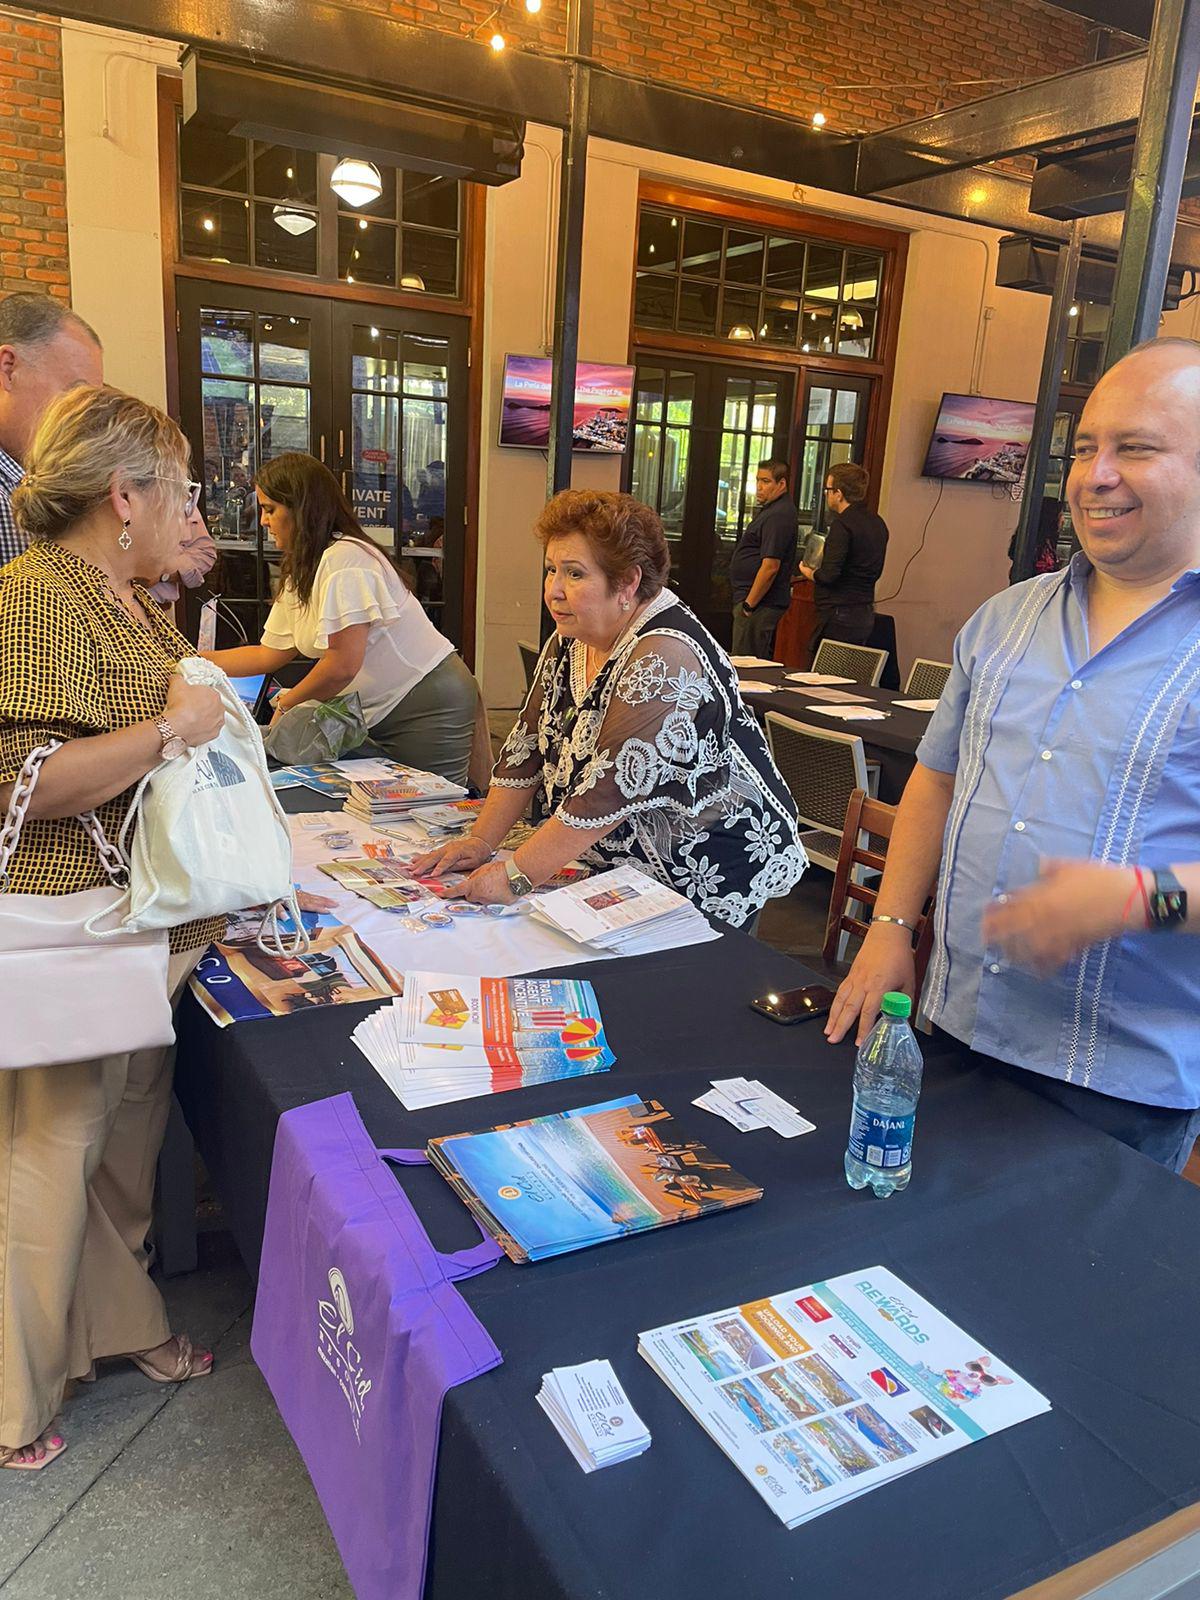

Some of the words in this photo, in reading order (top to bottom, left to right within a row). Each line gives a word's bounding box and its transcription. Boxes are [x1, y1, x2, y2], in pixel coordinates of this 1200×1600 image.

[352, 488, 392, 503] IVATE
[516, 979, 529, 1018] INCENTIVE
[526, 979, 540, 1004] AGENT
[541, 979, 553, 1006] TRAVEL
[872, 1118, 905, 1130] DASANI
[854, 1280, 932, 1343] REWARDS
[754, 1310, 787, 1340] BOOKINGS
[782, 1339, 799, 1353] AND
[761, 1308, 789, 1333] UPLOAD
[784, 1333, 806, 1351] YOUR
